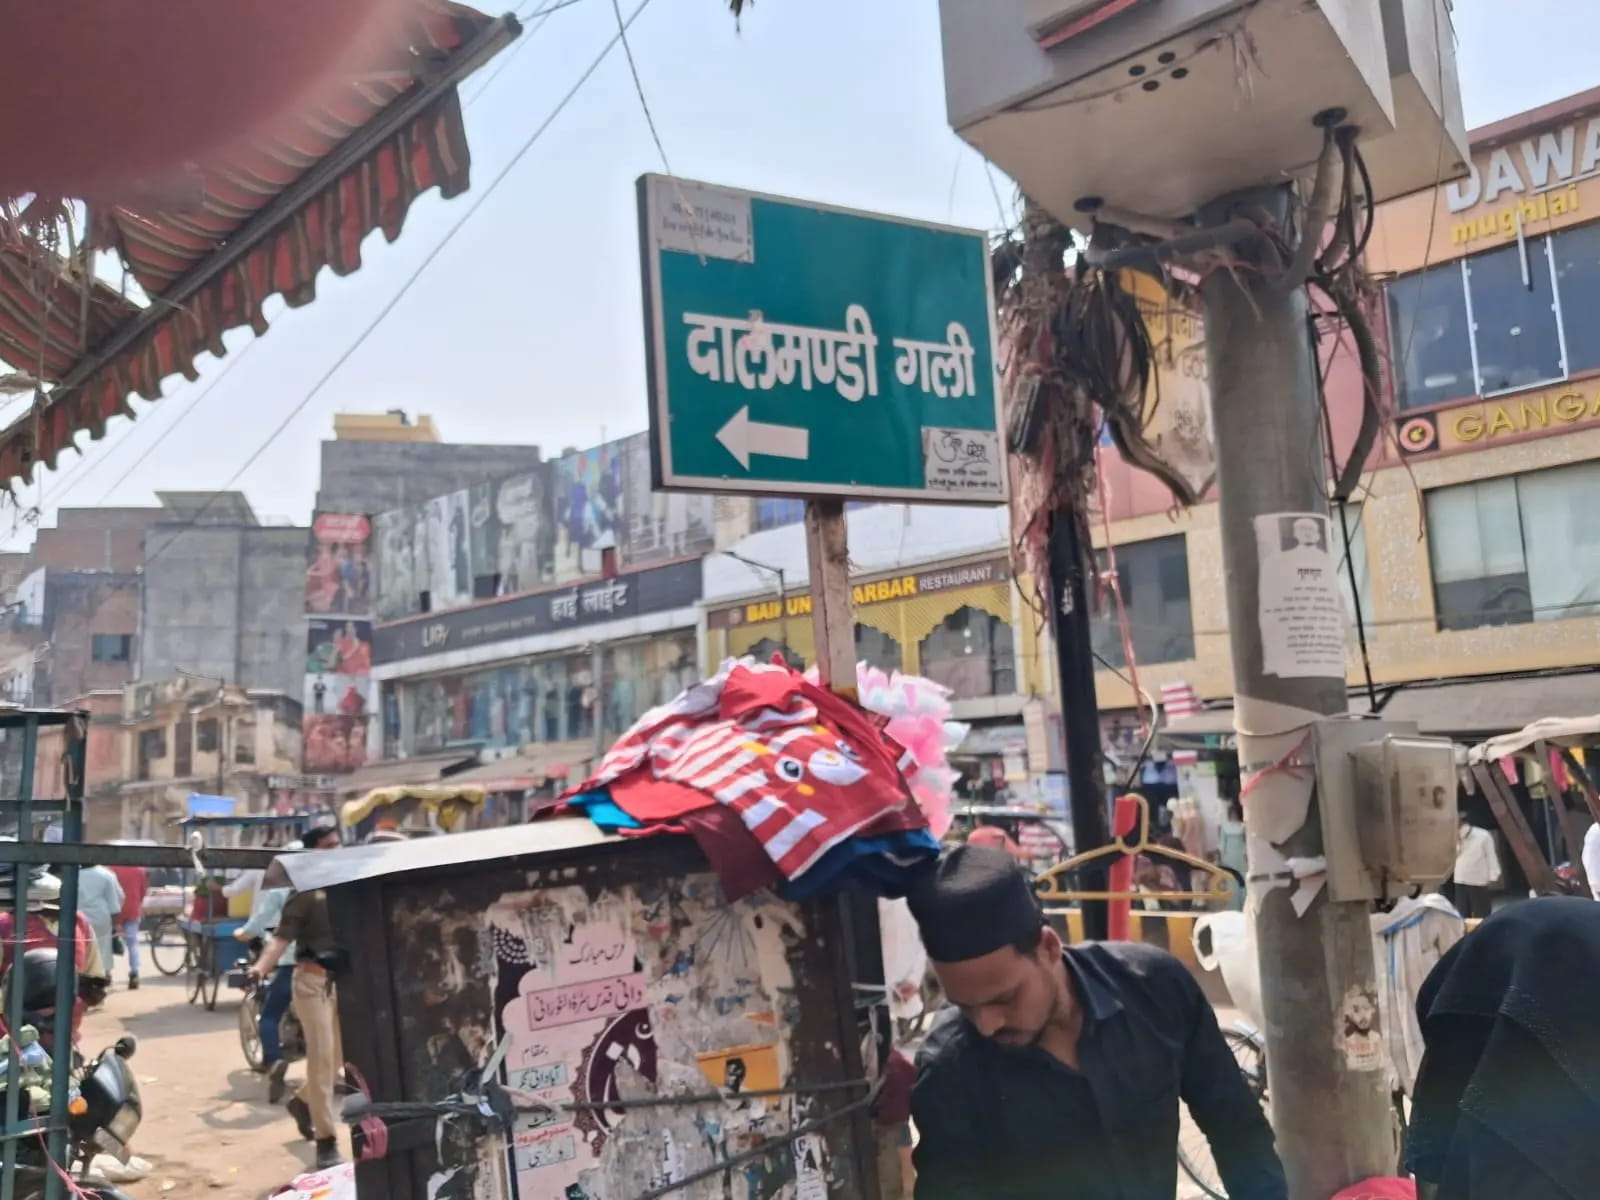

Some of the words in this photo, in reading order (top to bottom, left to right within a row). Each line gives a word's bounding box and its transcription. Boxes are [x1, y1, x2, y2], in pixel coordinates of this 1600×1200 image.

[1452, 183, 1579, 245] mughlai
[682, 304, 878, 402] दालमण्डी
[892, 322, 976, 398] गली
[852, 576, 918, 605] ARBAR
[919, 566, 993, 592] RESTAURANT
